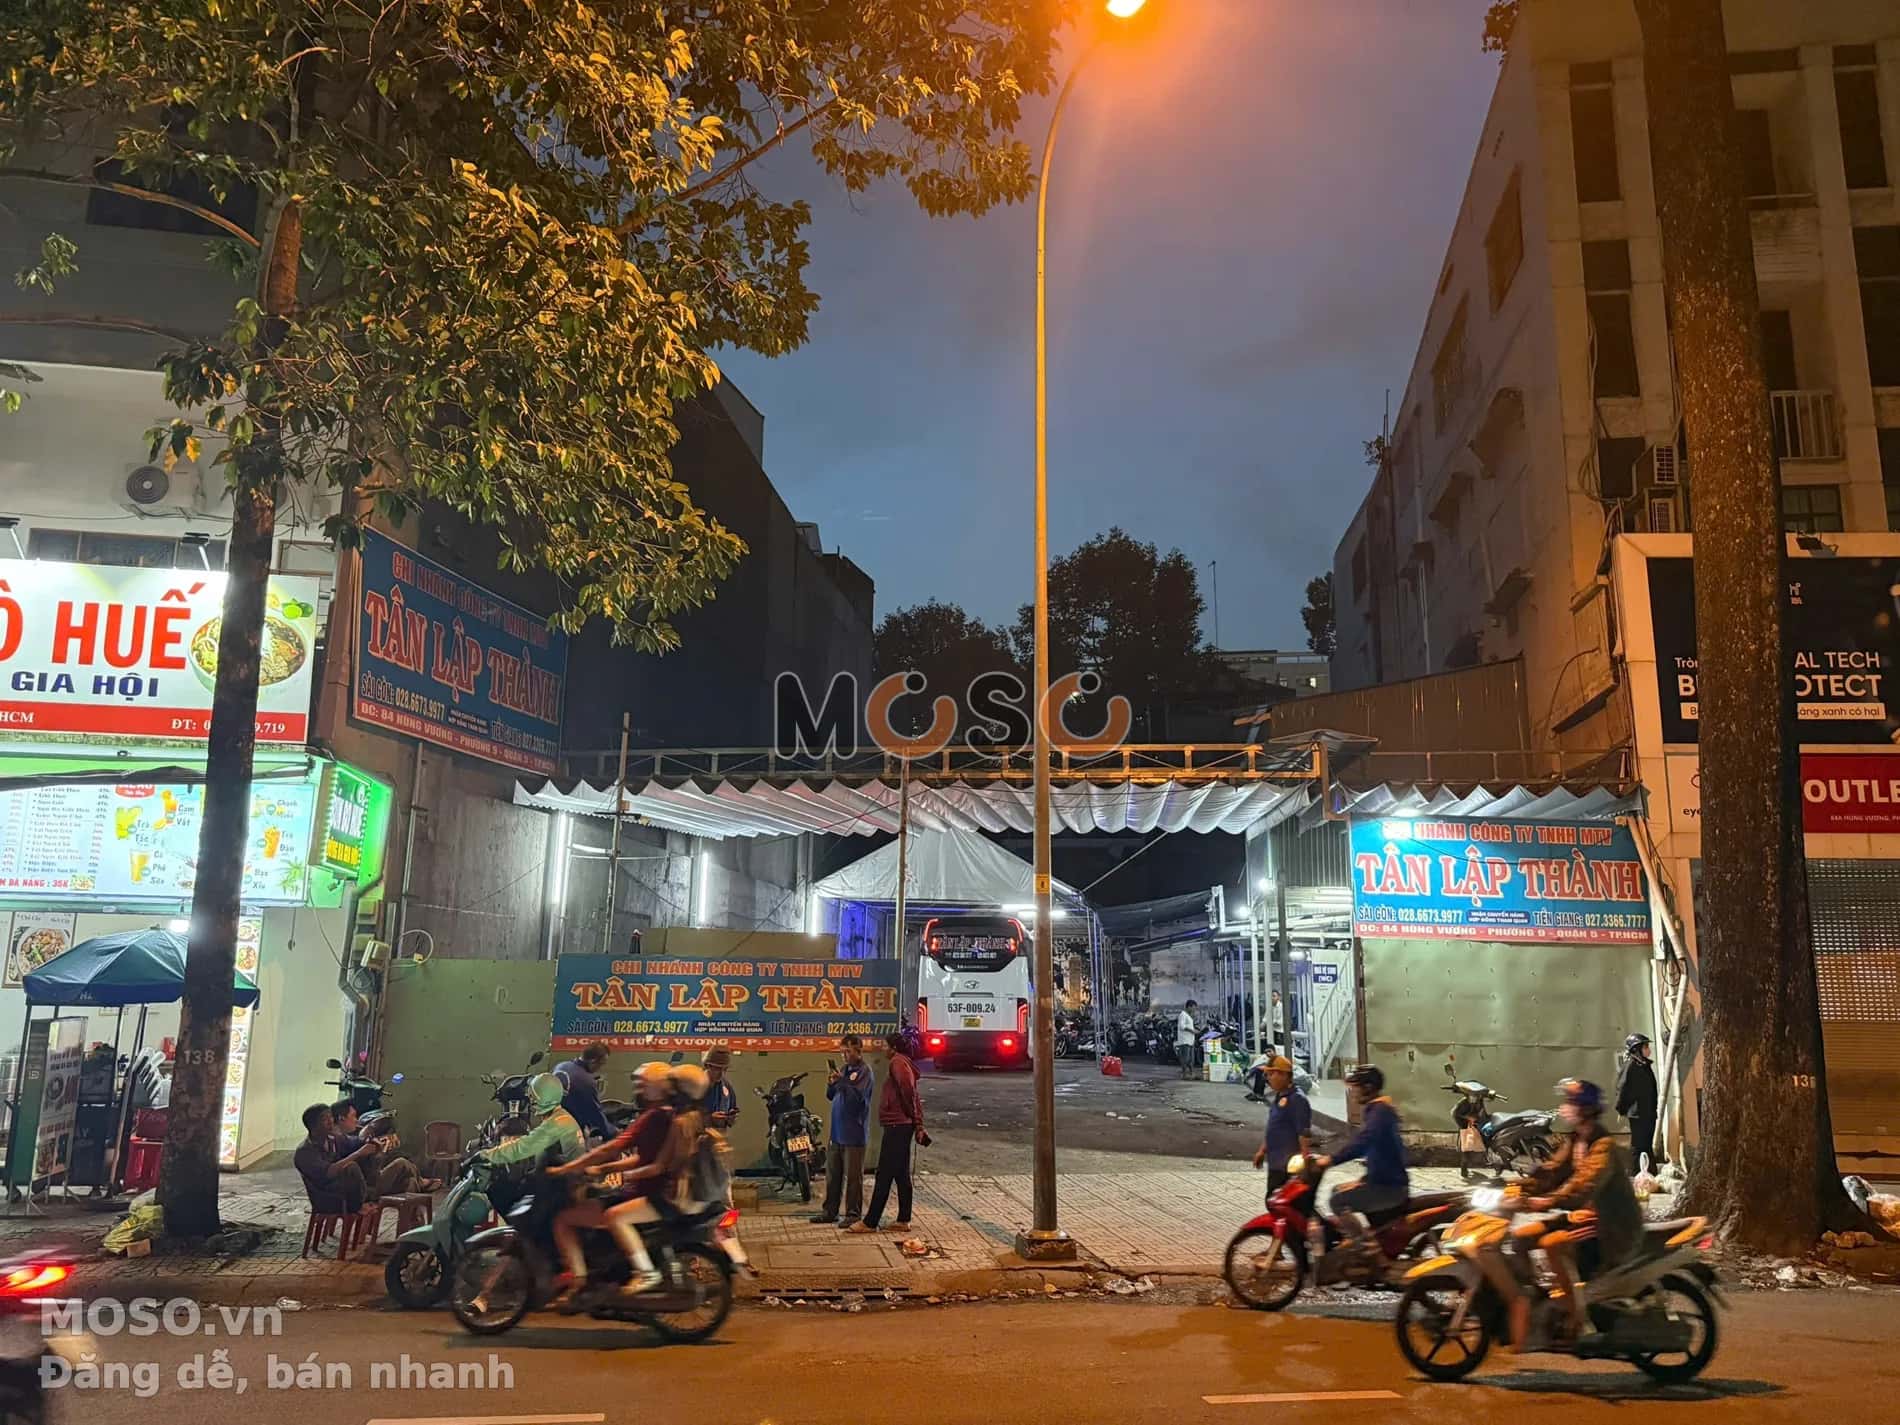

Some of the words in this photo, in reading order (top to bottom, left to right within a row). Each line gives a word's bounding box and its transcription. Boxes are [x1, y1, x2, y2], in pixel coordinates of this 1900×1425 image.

[51, 582, 206, 670] HUẾ
[365, 584, 428, 674] TÂN
[432, 616, 483, 704] LẬP
[487, 646, 562, 725] THÀNH
[1674, 657, 1698, 668] Trò
[1824, 651, 1880, 668] TECH
[11, 671, 76, 693] GIA
[92, 672, 159, 700] HỘI
[1822, 707, 1847, 716] xanh
[171, 719, 197, 731] ĐT:
[1469, 821, 1512, 842] CÔNG
[1514, 825, 1533, 843] TY
[1536, 825, 1577, 844] TNHH
[1580, 827, 1613, 846] MTV
[1355, 841, 1432, 896] TÂN
[1439, 845, 1512, 907] LẬP
[1517, 847, 1645, 901] THÀNH
[1359, 902, 1374, 920] SÀI
[1375, 903, 1396, 921] GÒN:
[1398, 908, 1462, 923] 028.6673.9977
[1533, 907, 1553, 926] TIỀN
[1554, 912, 1584, 927] GIANG:
[612, 960, 642, 975] CHI
[646, 959, 704, 976] NHÁNH
[708, 960, 753, 976] CÔNG
[757, 962, 778, 977] TY
[781, 963, 824, 978] TNHH
[828, 964, 864, 979] MTV
[571, 975, 660, 1011] TÂN
[668, 977, 749, 1018] LẬP
[757, 979, 898, 1013] THÀNH
[567, 1017, 585, 1033] SÀI
[587, 1017, 611, 1034] GÒN:
[613, 1020, 689, 1034] 028.6673.9977
[770, 1018, 791, 1034] TIỀN
[827, 1022, 897, 1034] 027.3366.7777
